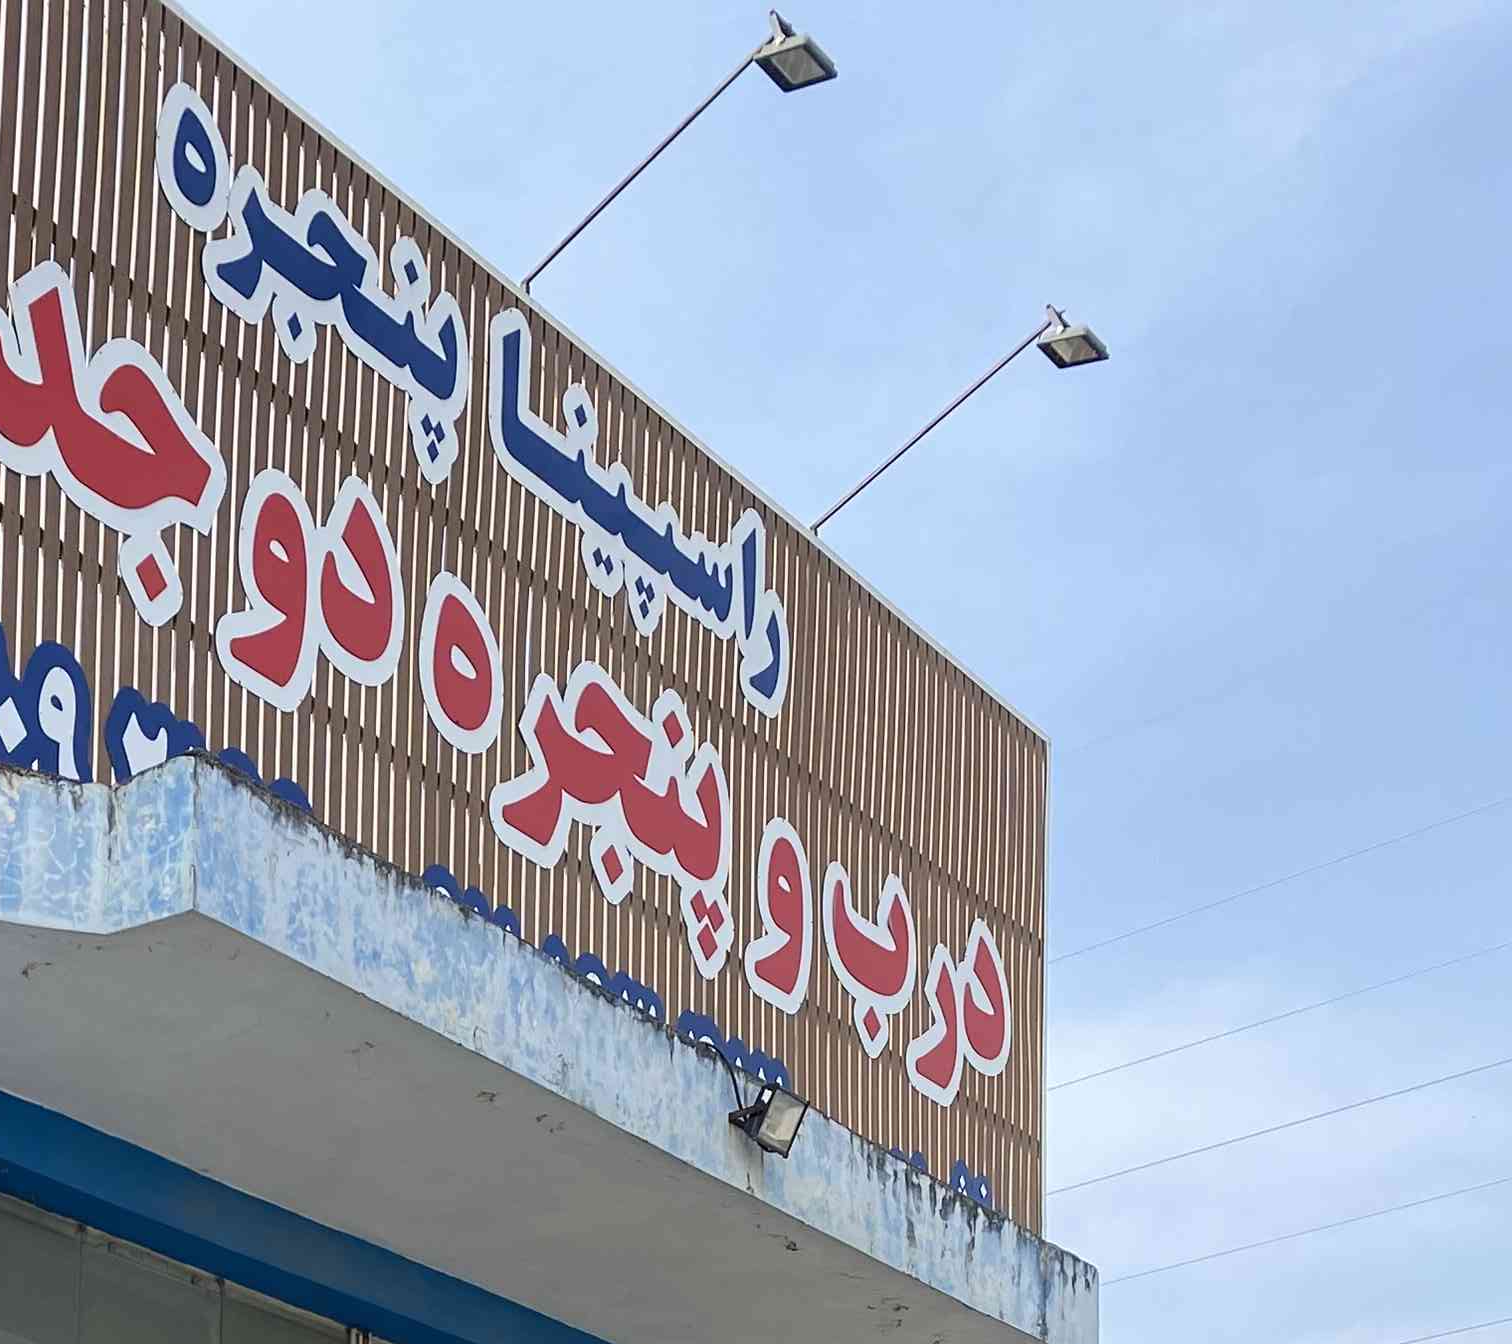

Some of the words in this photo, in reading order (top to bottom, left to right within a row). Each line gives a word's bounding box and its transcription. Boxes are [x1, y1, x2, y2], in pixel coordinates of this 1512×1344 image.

[165, 95, 462, 472] پنجره
[222, 481, 398, 700] دو
[496, 320, 785, 708] راسپینا
[427, 583, 730, 971] پنجره
[750, 827, 808, 1004] و
[828, 867, 1009, 1098] درب
